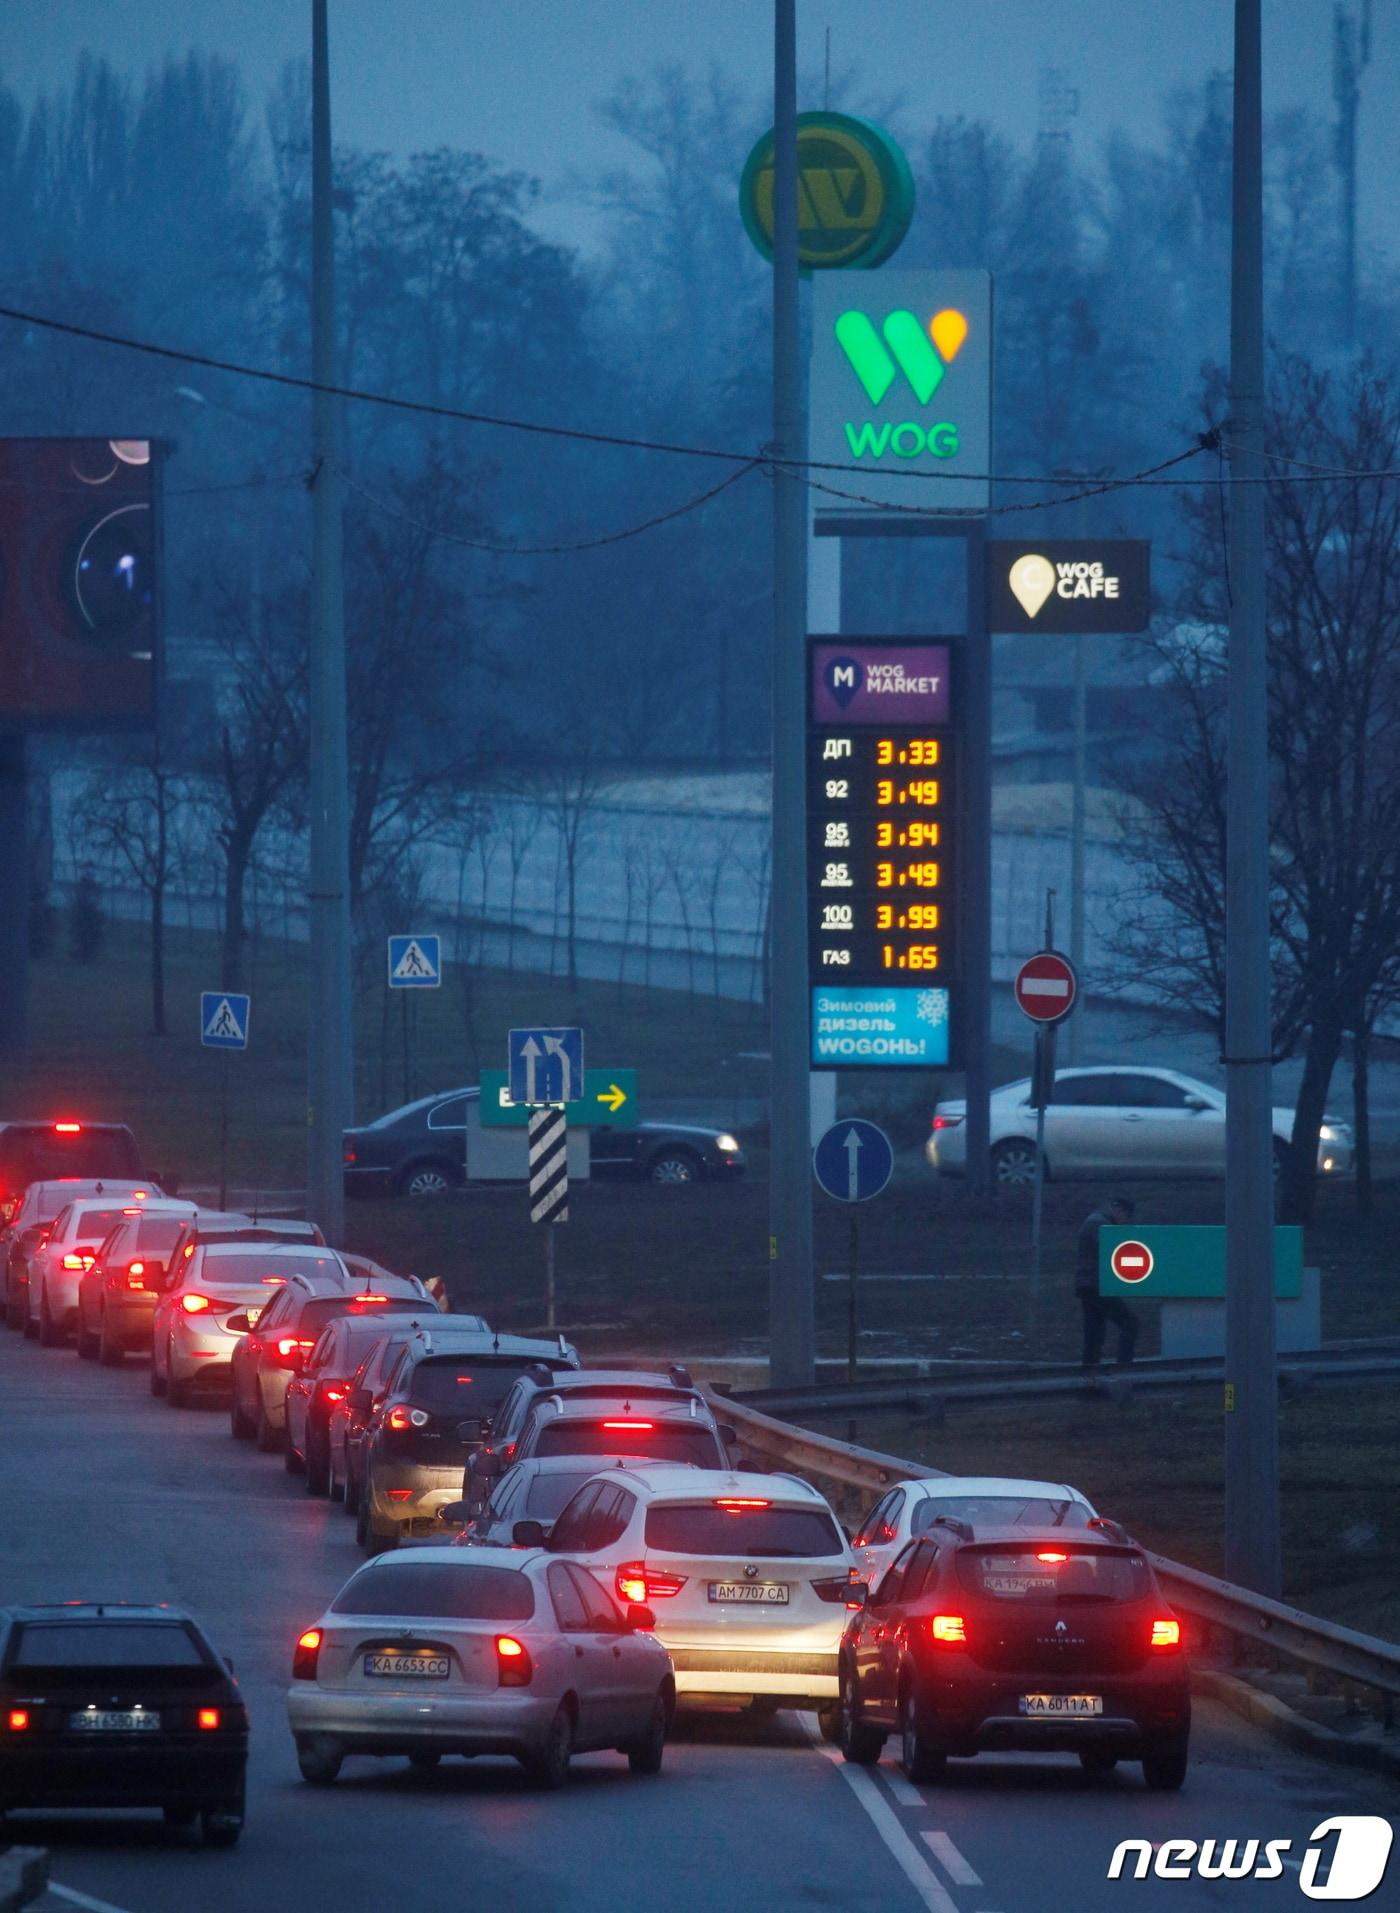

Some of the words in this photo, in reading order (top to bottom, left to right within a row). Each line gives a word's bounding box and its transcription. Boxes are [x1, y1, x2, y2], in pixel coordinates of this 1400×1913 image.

[844, 422, 960, 458] WOG
[1056, 562, 1104, 578] WOG
[1056, 577, 1120, 598] CAFE
[834, 666, 854, 687] M
[867, 665, 904, 677] WOG
[867, 678, 940, 693] MARKET
[823, 739, 851, 759] ДП
[825, 780, 848, 798] 92
[825, 823, 849, 839] 95
[825, 863, 849, 879] 95
[823, 905, 852, 922] 100
[823, 950, 850, 964] ГАЗ
[818, 998, 896, 1013] Зимовий
[818, 1018, 896, 1032] дизель
[718, 1586, 735, 1598] AM
[739, 1587, 764, 1599] 7707
[768, 1588, 784, 1600] CA
[373, 1658, 391, 1671] KA
[395, 1659, 424, 1672] 6653
[428, 1661, 447, 1673] CC
[1026, 1697, 1044, 1710] KA
[1048, 1698, 1077, 1710] 6011
[1080, 1698, 1097, 1710] AT
